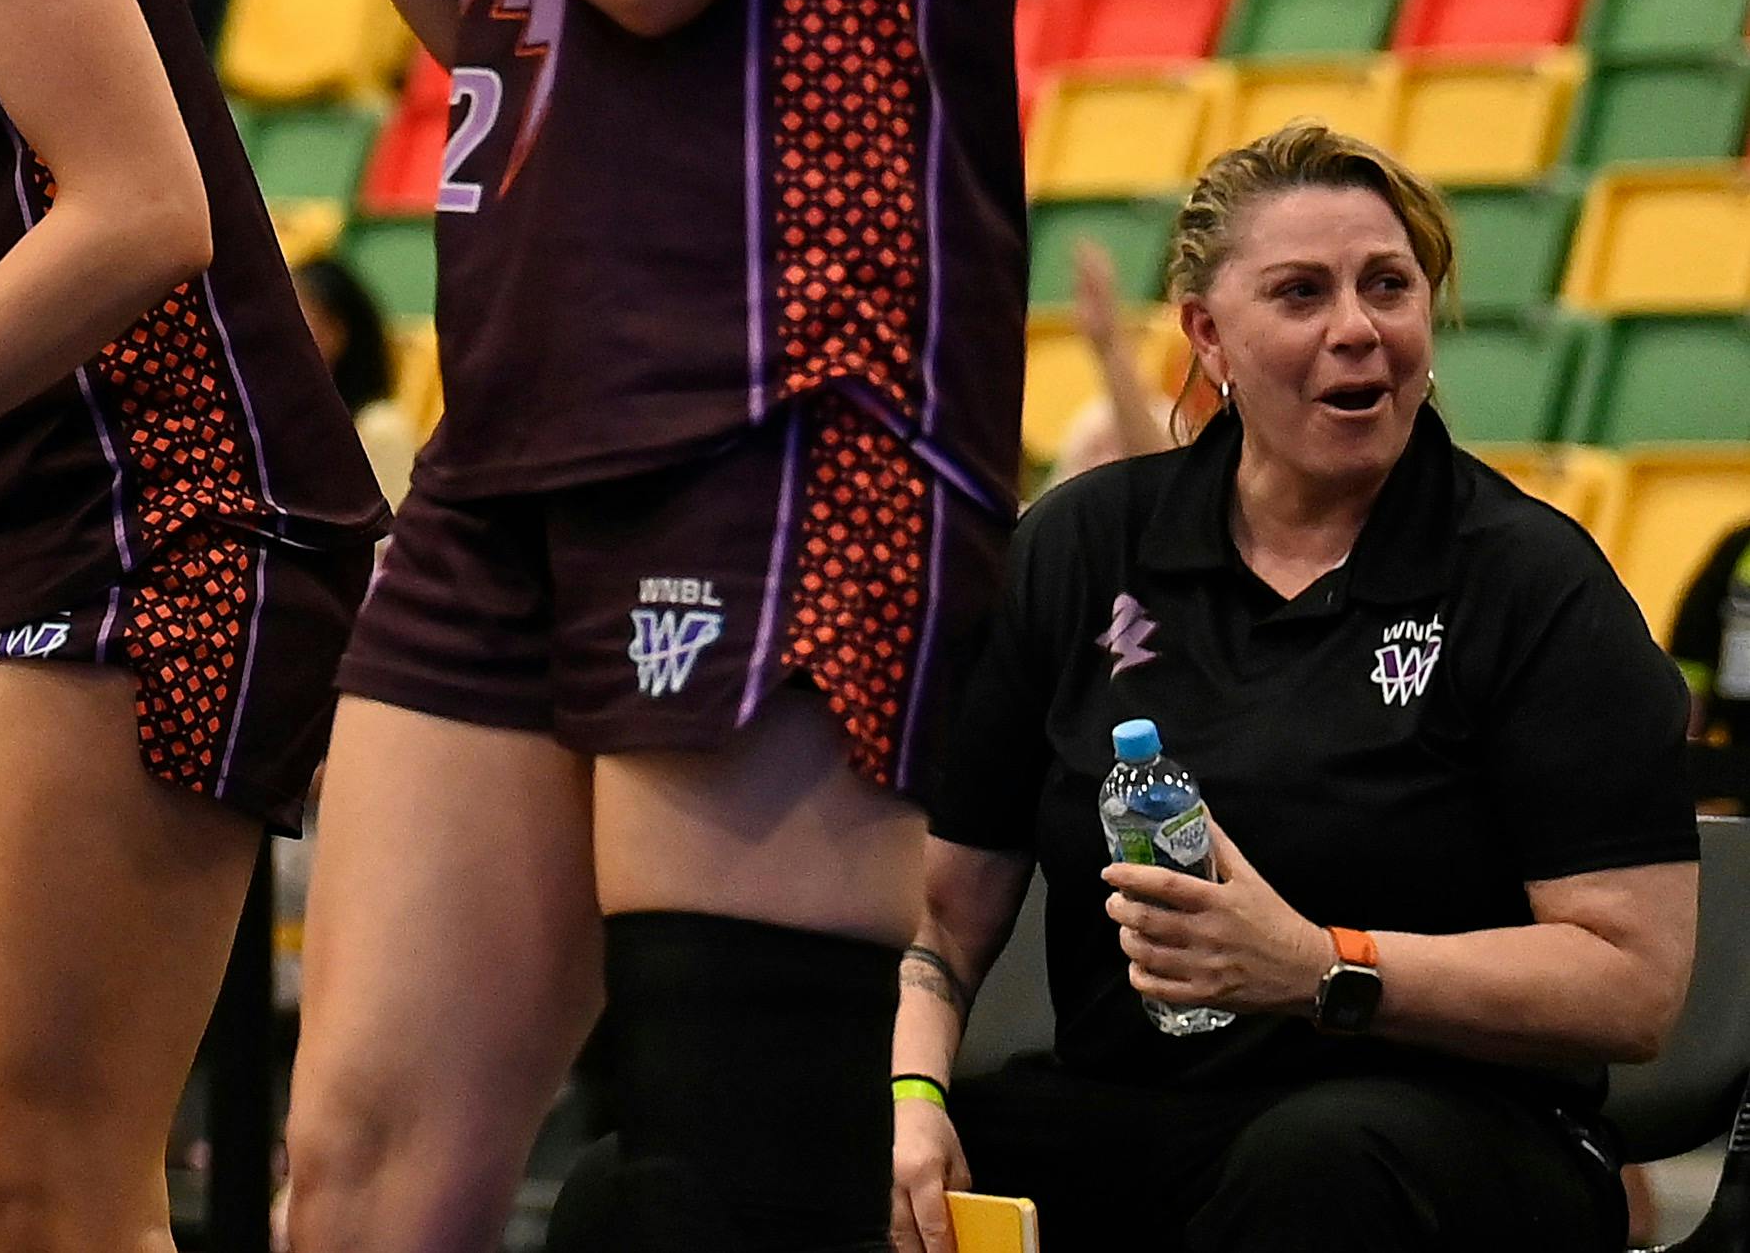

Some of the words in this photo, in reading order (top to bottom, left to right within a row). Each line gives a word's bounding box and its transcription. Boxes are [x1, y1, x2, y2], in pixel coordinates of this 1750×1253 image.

[435, 66, 503, 213] 2
[639, 577, 723, 607] WNBL
[1383, 613, 1444, 643] WNL
